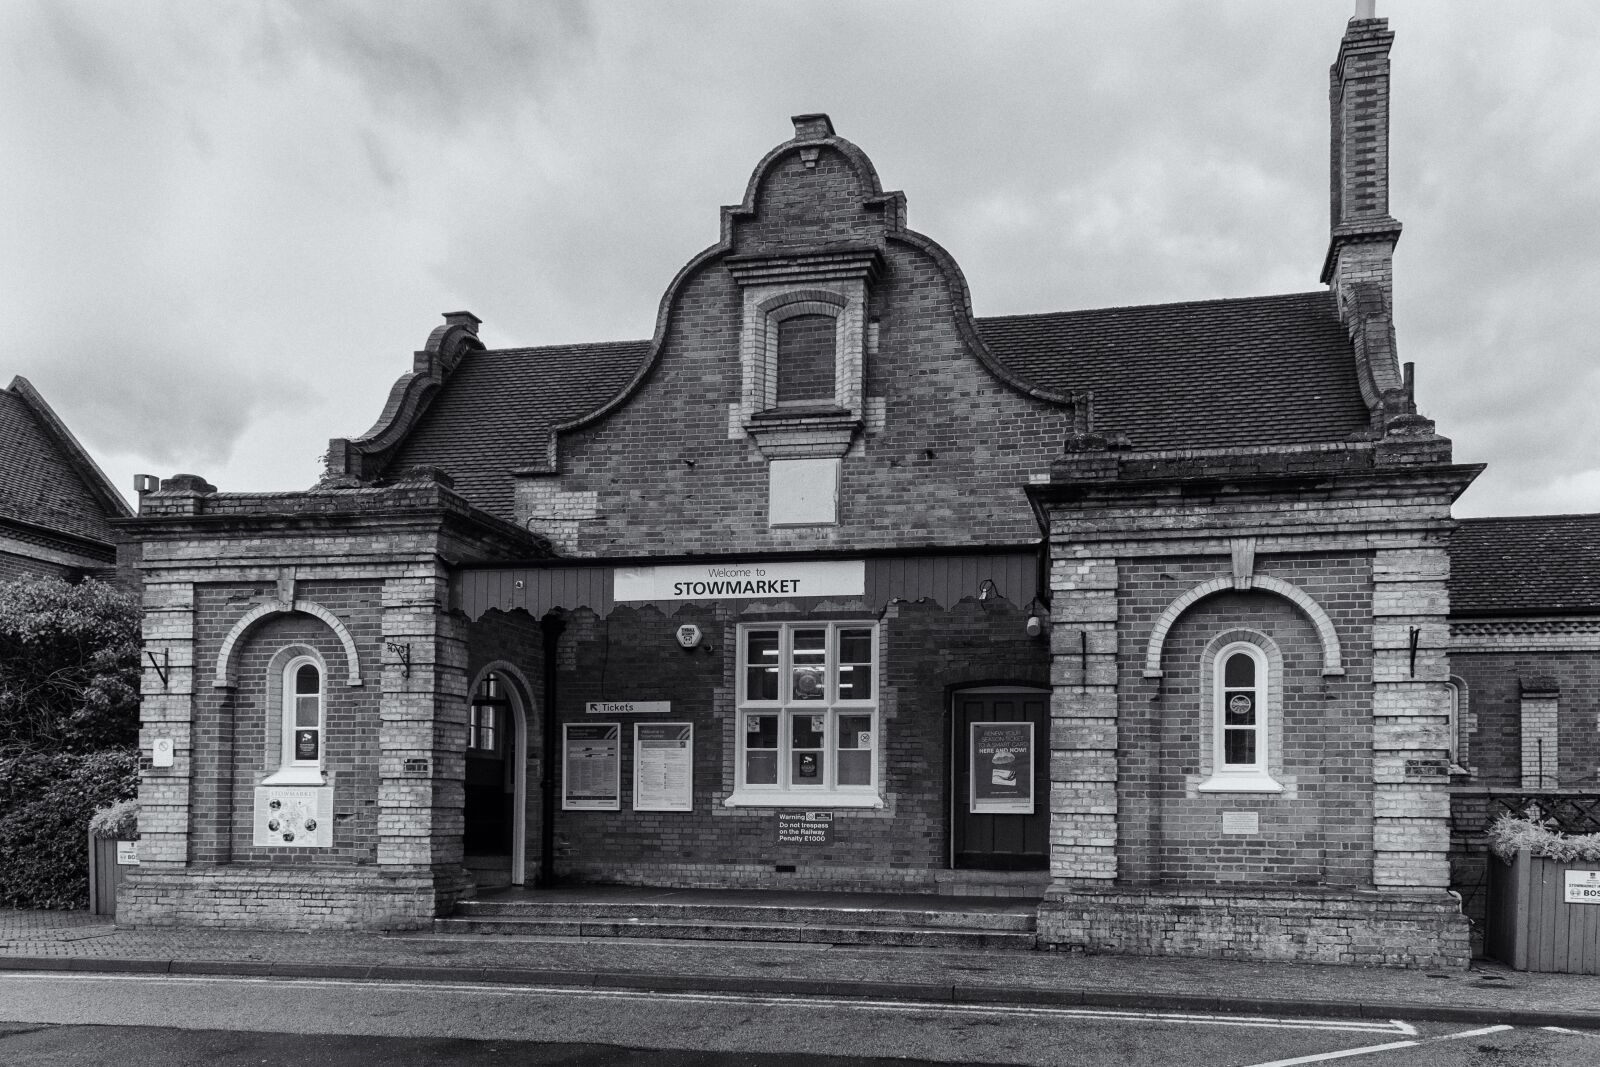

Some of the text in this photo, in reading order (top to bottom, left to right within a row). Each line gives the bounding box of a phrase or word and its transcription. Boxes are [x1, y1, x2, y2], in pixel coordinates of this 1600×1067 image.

[708, 568, 766, 578] Welcome to
[674, 579, 800, 596] STOWMARKET
[602, 703, 634, 711] Tickets
